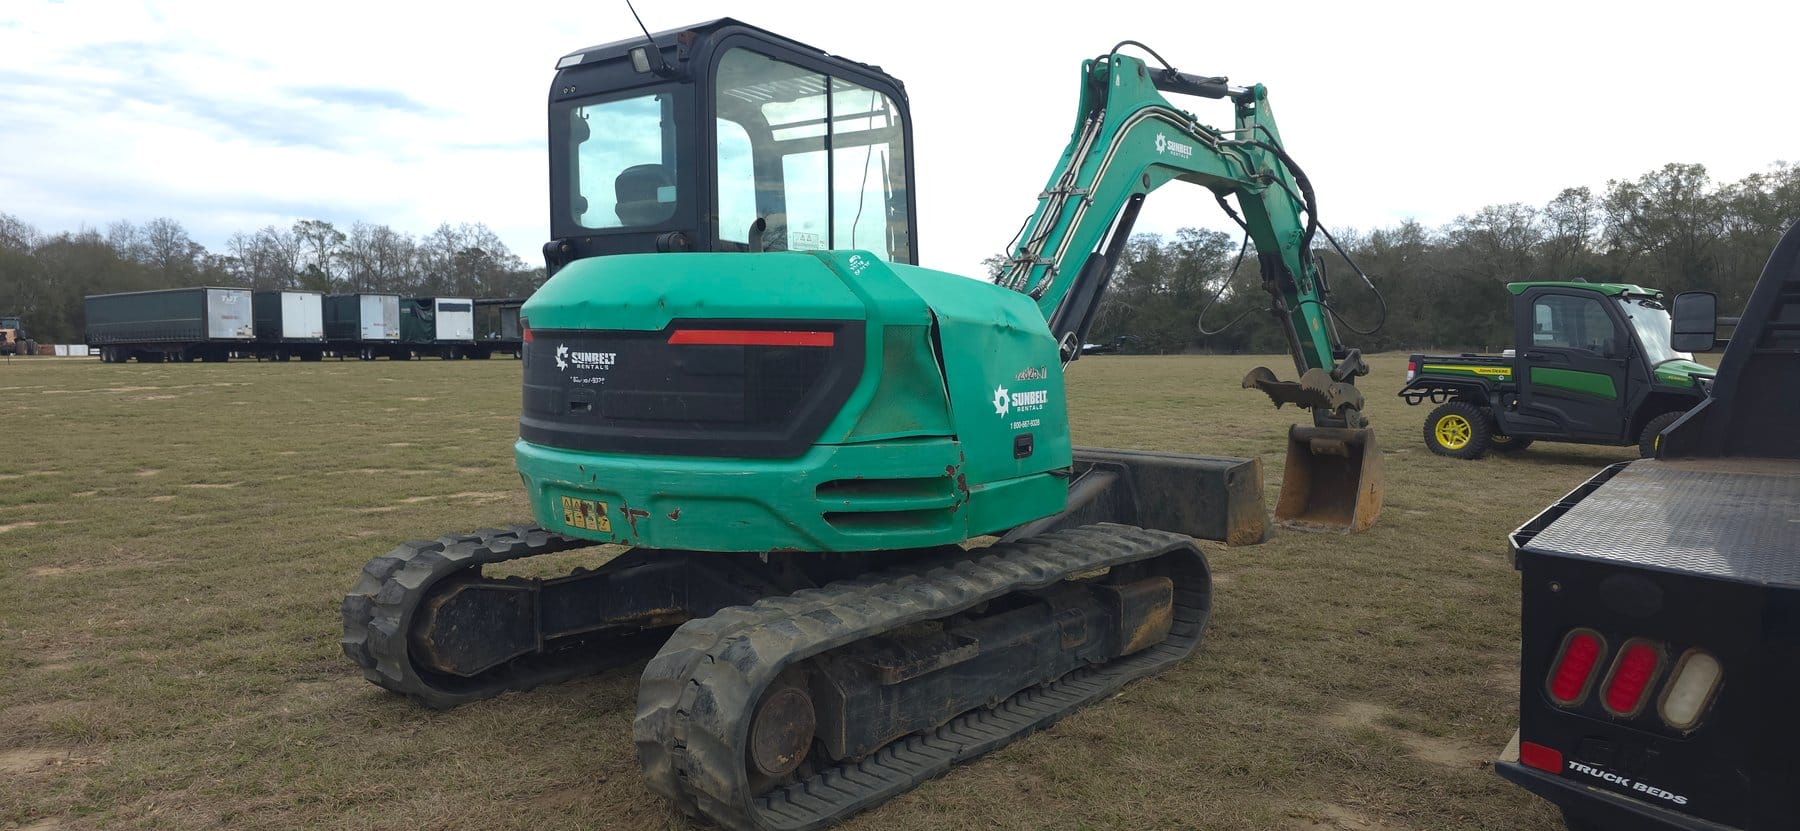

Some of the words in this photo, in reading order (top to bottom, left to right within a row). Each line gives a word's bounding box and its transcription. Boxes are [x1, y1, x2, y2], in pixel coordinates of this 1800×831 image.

[1167, 140, 1192, 156] SUNBELT
[571, 352, 616, 365] SUNBELT
[1011, 390, 1047, 407] SUNBELT
[1017, 404, 1043, 412] RENTALS
[1568, 760, 1631, 787] TRUCK
[1633, 782, 1688, 805] BEDS
